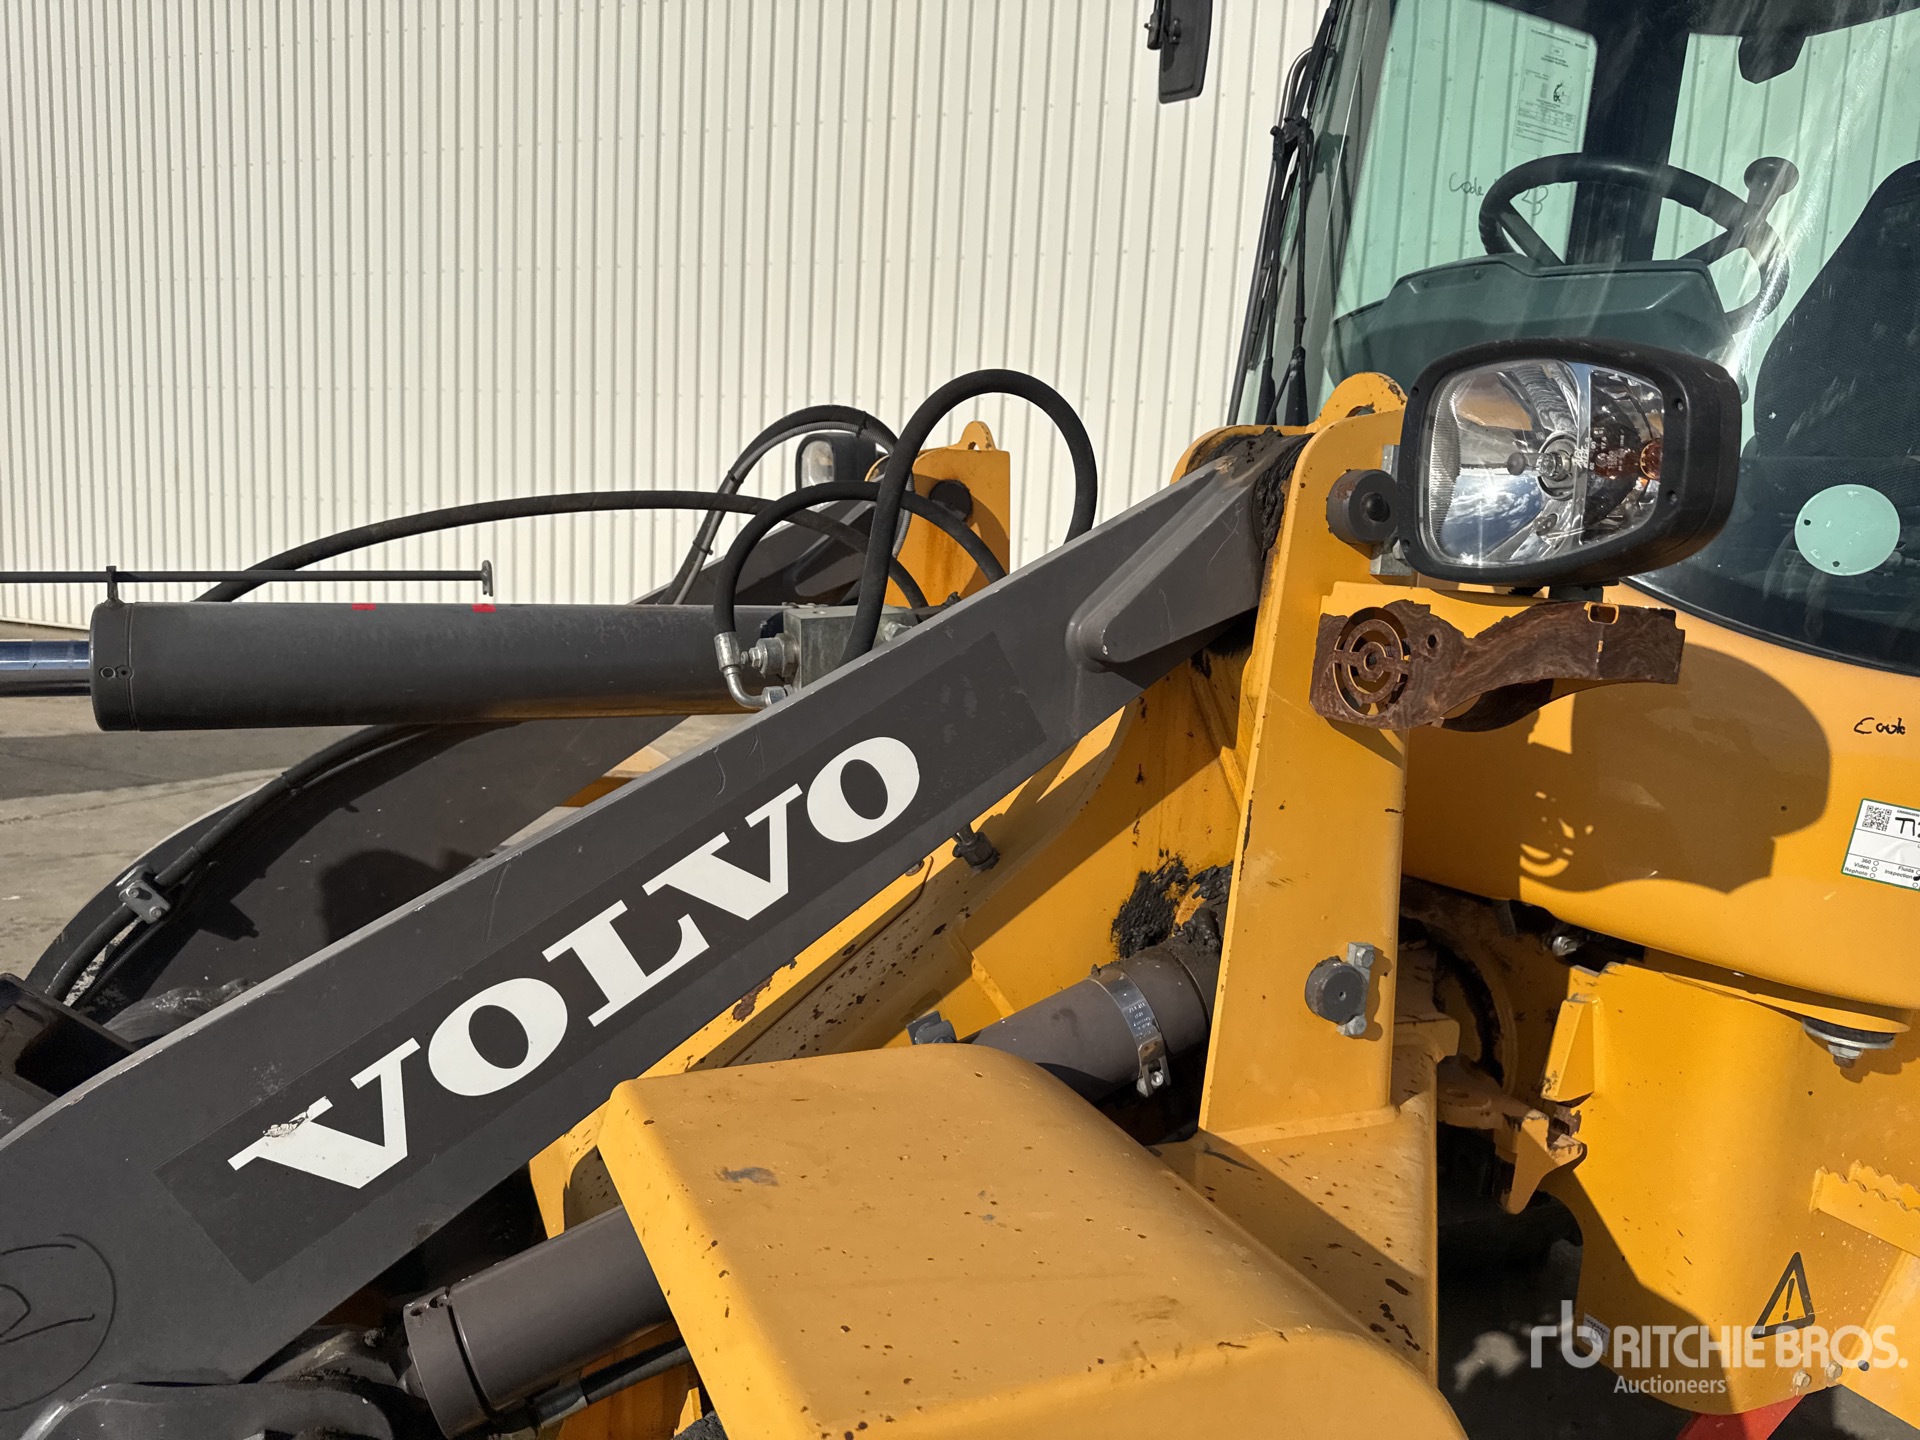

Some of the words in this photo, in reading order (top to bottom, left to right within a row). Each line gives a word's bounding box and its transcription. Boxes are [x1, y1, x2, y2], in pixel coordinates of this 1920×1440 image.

[1449, 172, 1484, 196] Code
[1844, 866, 1869, 876] Rephoto
[1854, 862, 1870, 870] Video
[1898, 865, 1915, 873] Fluids
[1884, 869, 1913, 880] Inspection
[228, 736, 920, 1190] VOLVO
